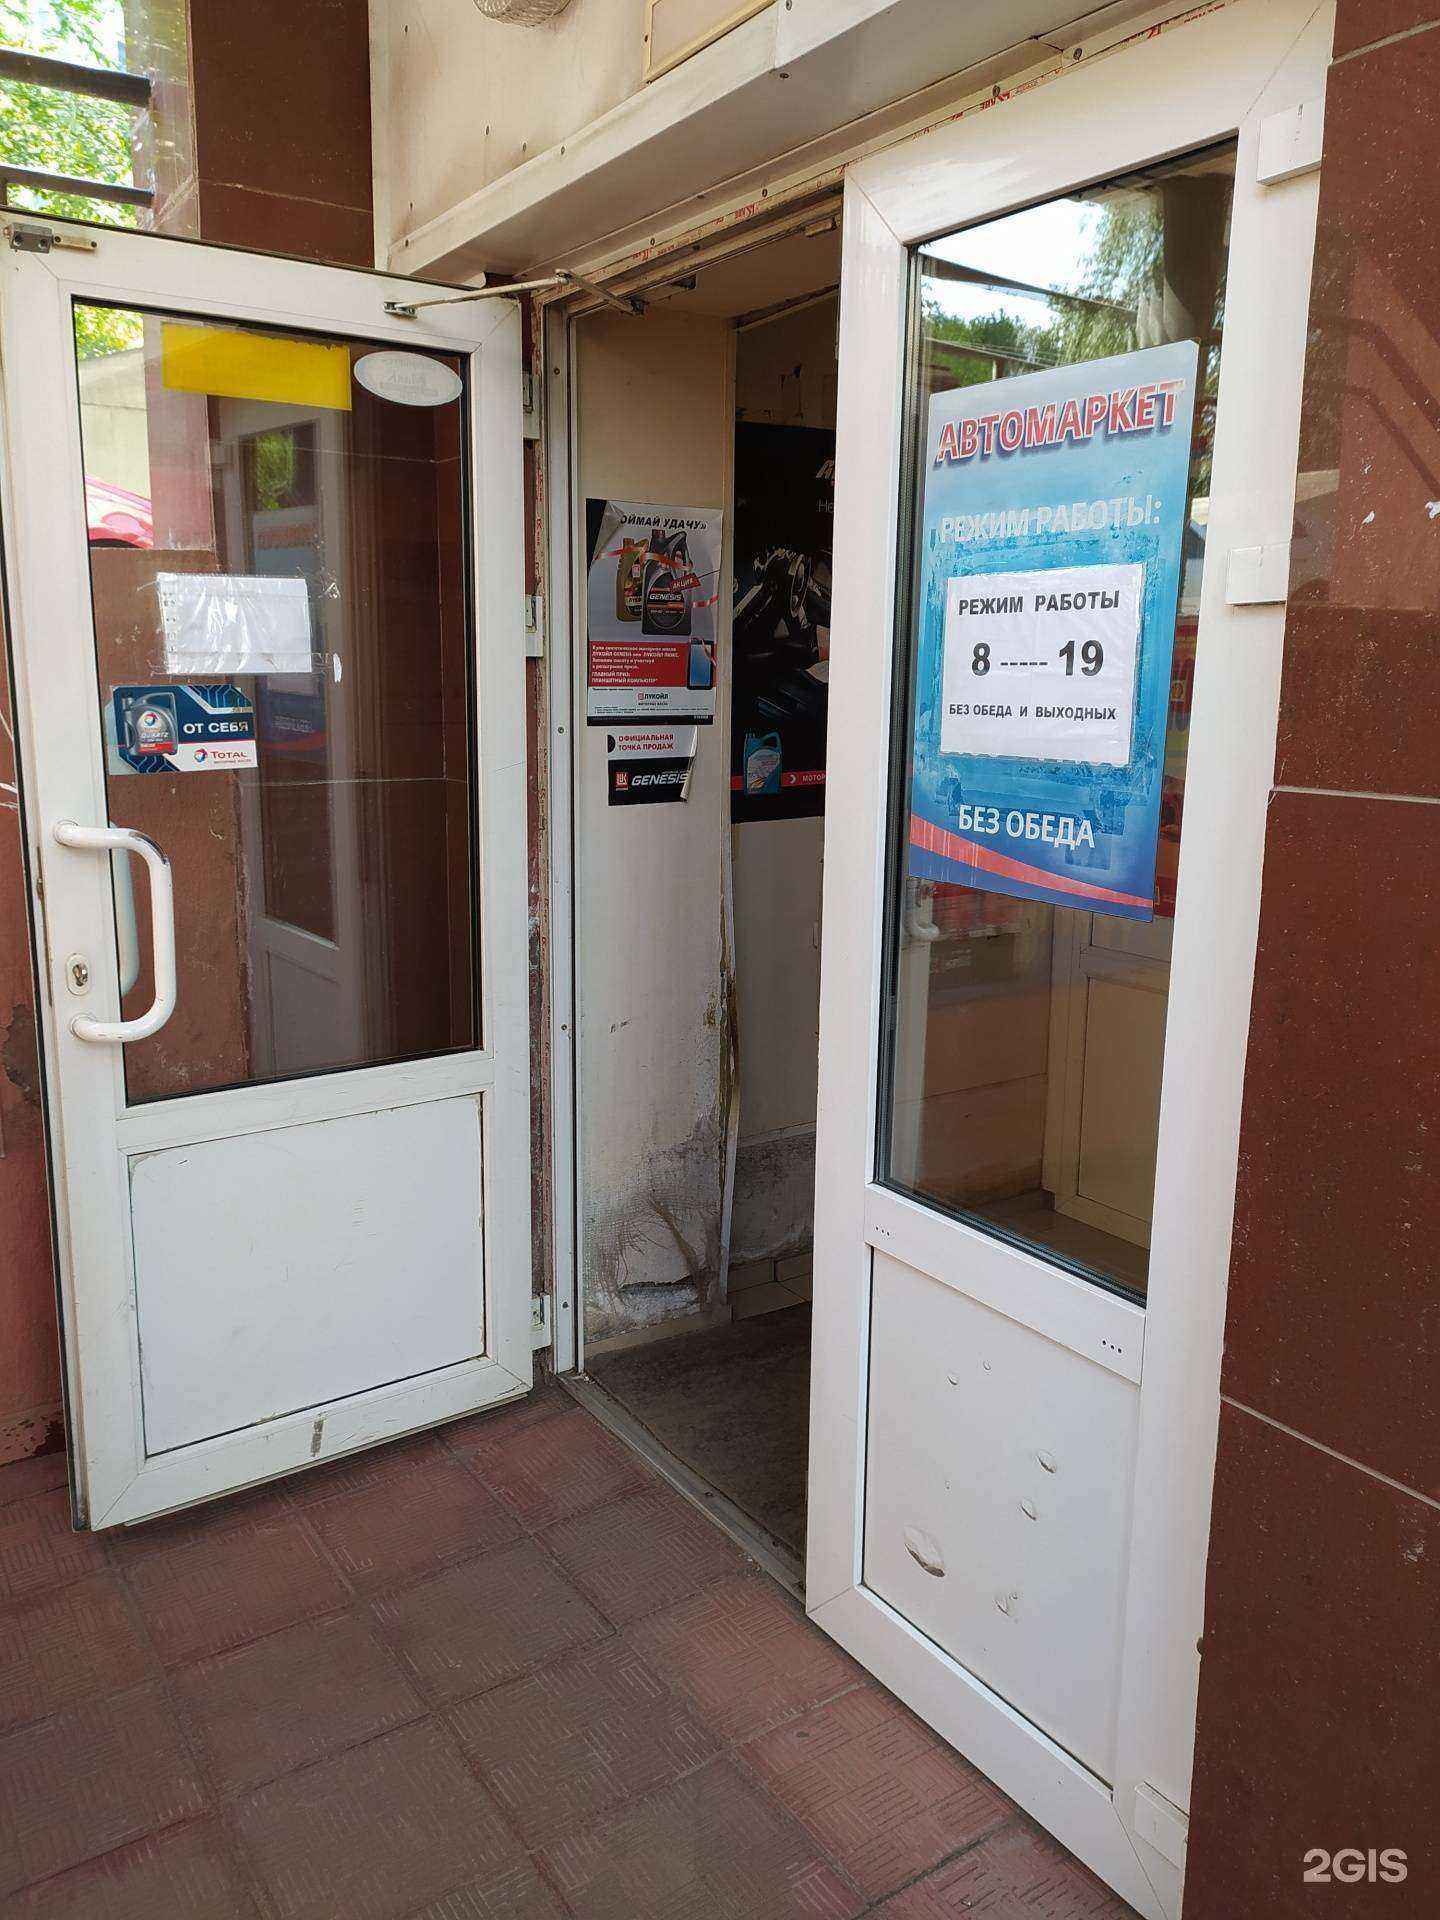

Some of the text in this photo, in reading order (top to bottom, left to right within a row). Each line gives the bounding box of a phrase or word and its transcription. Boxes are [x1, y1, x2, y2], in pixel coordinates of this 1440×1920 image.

[936, 379, 1186, 463] АВТОМАРКЕТ
[620, 513, 660, 528] ОЙМАЙ
[940, 494, 1162, 544] РЕЖИМ РАБОТЫ:
[958, 591, 1120, 616] РЕЖИМ РАБОТЫ
[971, 642, 991, 676] 8
[1058, 639, 1104, 677] 19
[644, 692, 669, 700] ЛУКОЙЛ
[949, 703, 1116, 721] БЕЗ ОБЕДА И ВЫХОДНЫХ
[183, 721, 249, 734] ОТ СЕБЯ
[618, 734, 674, 742] ОФИЦИАЛЬНАЯ
[643, 743, 674, 751] ПРОДАЖ
[211, 750, 248, 760] TOTAL
[631, 772, 689, 786] GENESIS
[802, 773, 826, 783] МОТОР
[958, 804, 1096, 851] БЕЗ ОБЕДА
